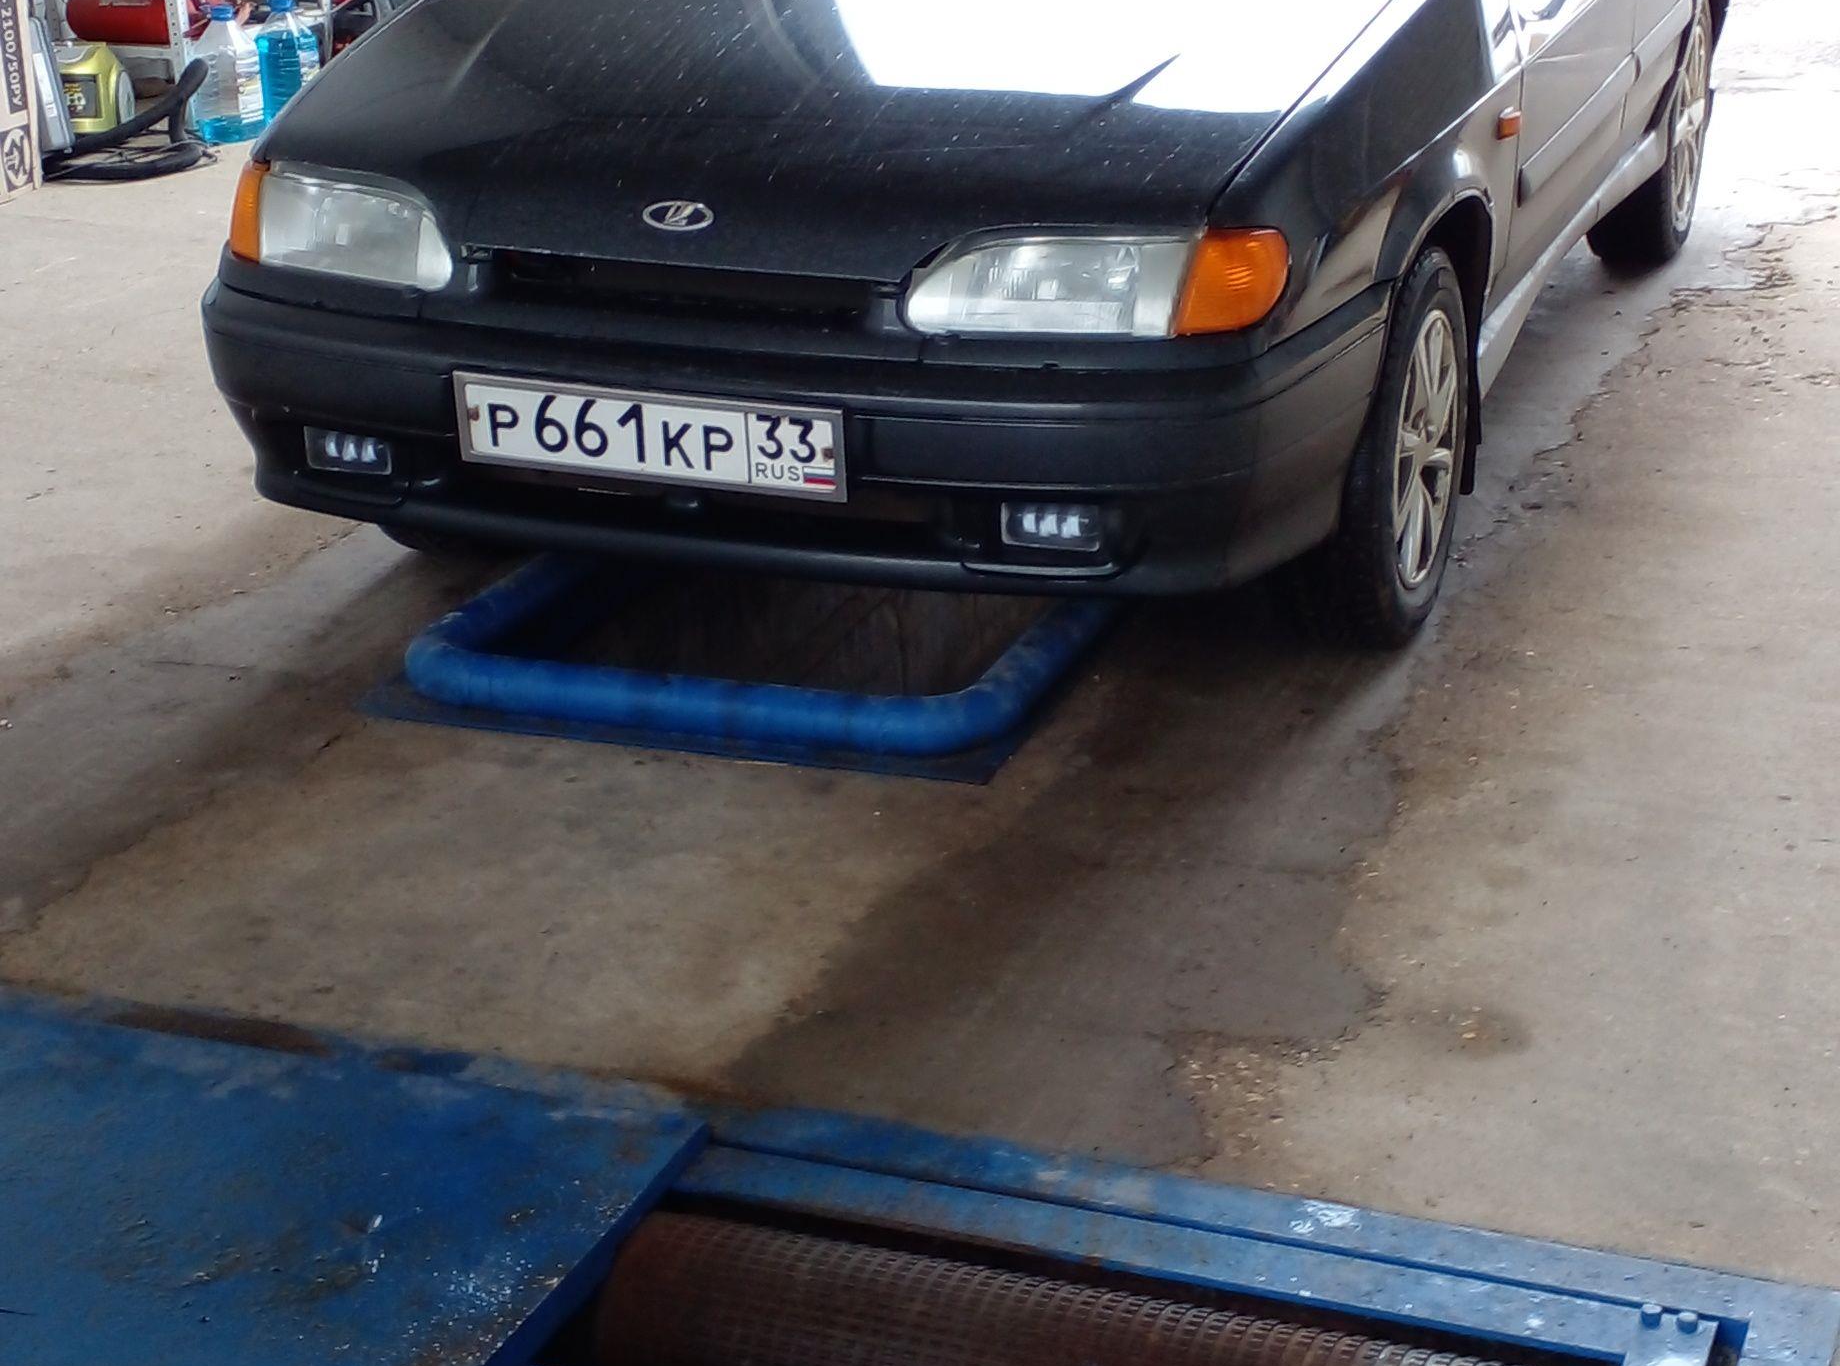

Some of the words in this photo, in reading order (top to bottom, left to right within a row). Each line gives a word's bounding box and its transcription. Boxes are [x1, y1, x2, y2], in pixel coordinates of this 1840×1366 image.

[486, 394, 734, 472] Р661КР
[756, 414, 816, 464] 33
[755, 462, 800, 482] RUS
